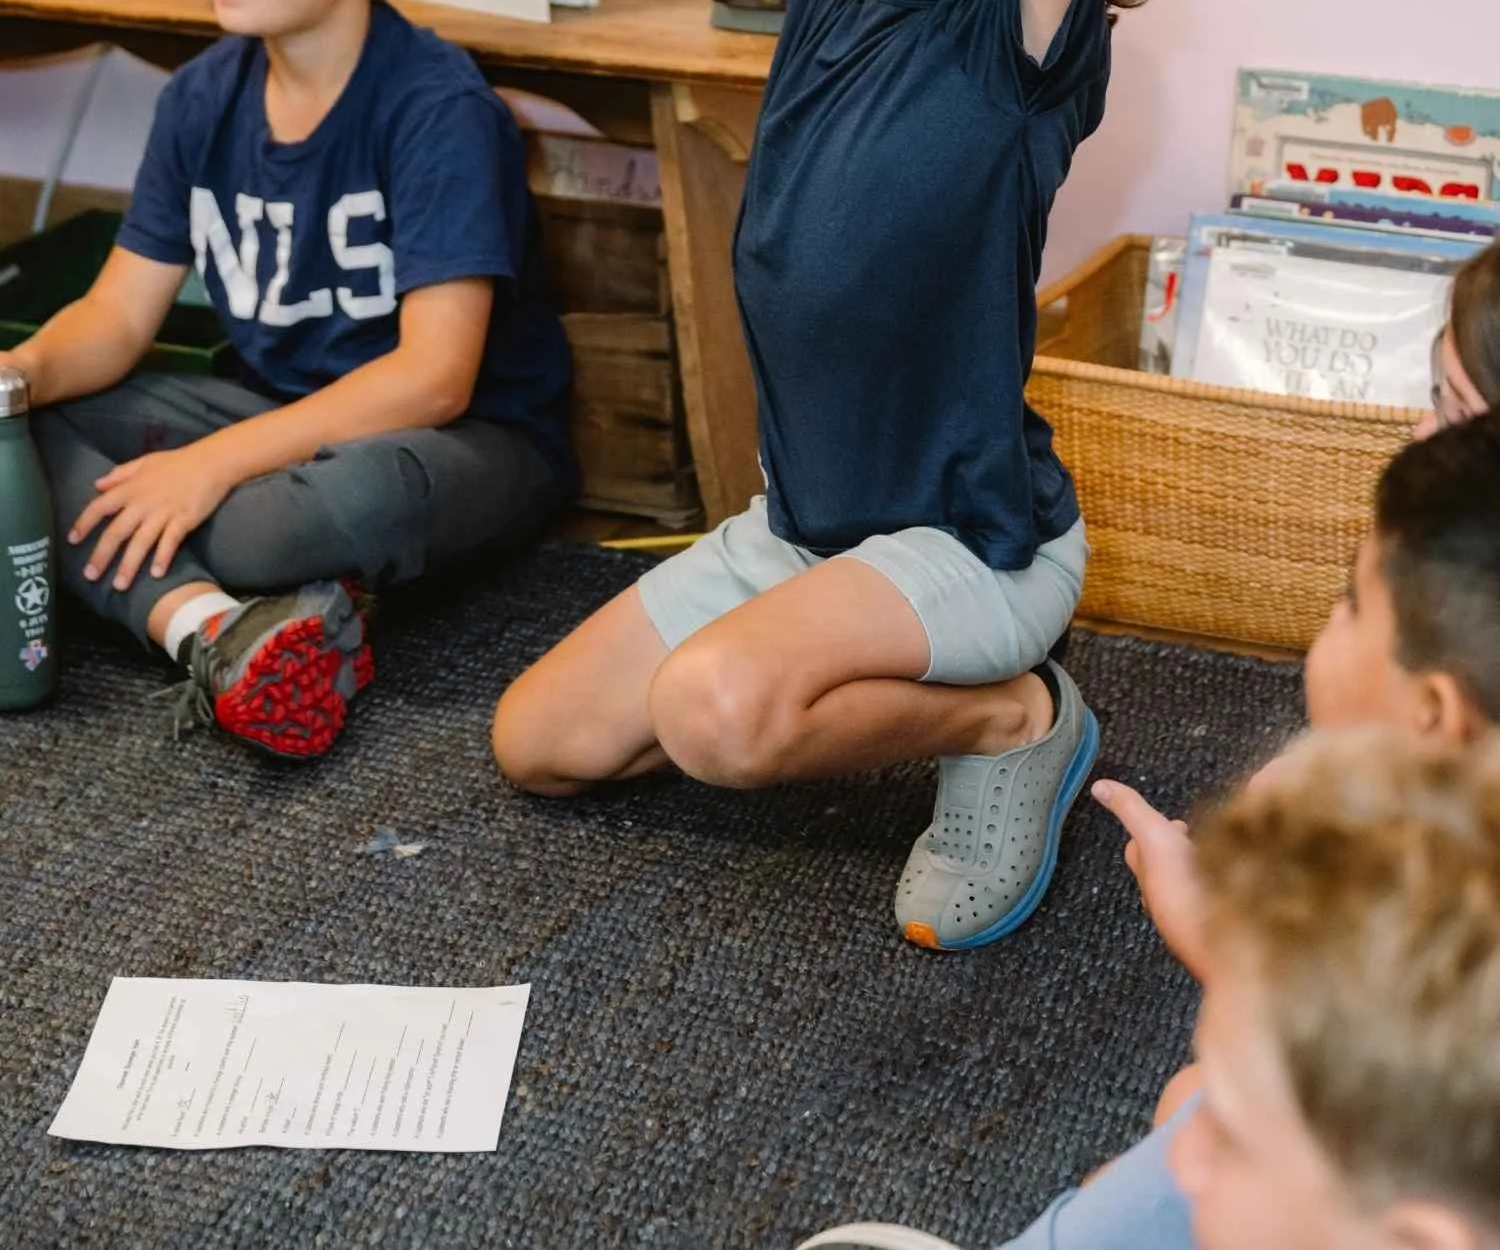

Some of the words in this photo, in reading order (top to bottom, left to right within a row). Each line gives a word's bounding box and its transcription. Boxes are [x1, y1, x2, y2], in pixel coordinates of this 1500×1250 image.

[190, 187, 398, 326] NLS
[1264, 316, 1337, 346] WHAT
[1340, 328, 1377, 352] DO
[1263, 337, 1321, 370] YOU
